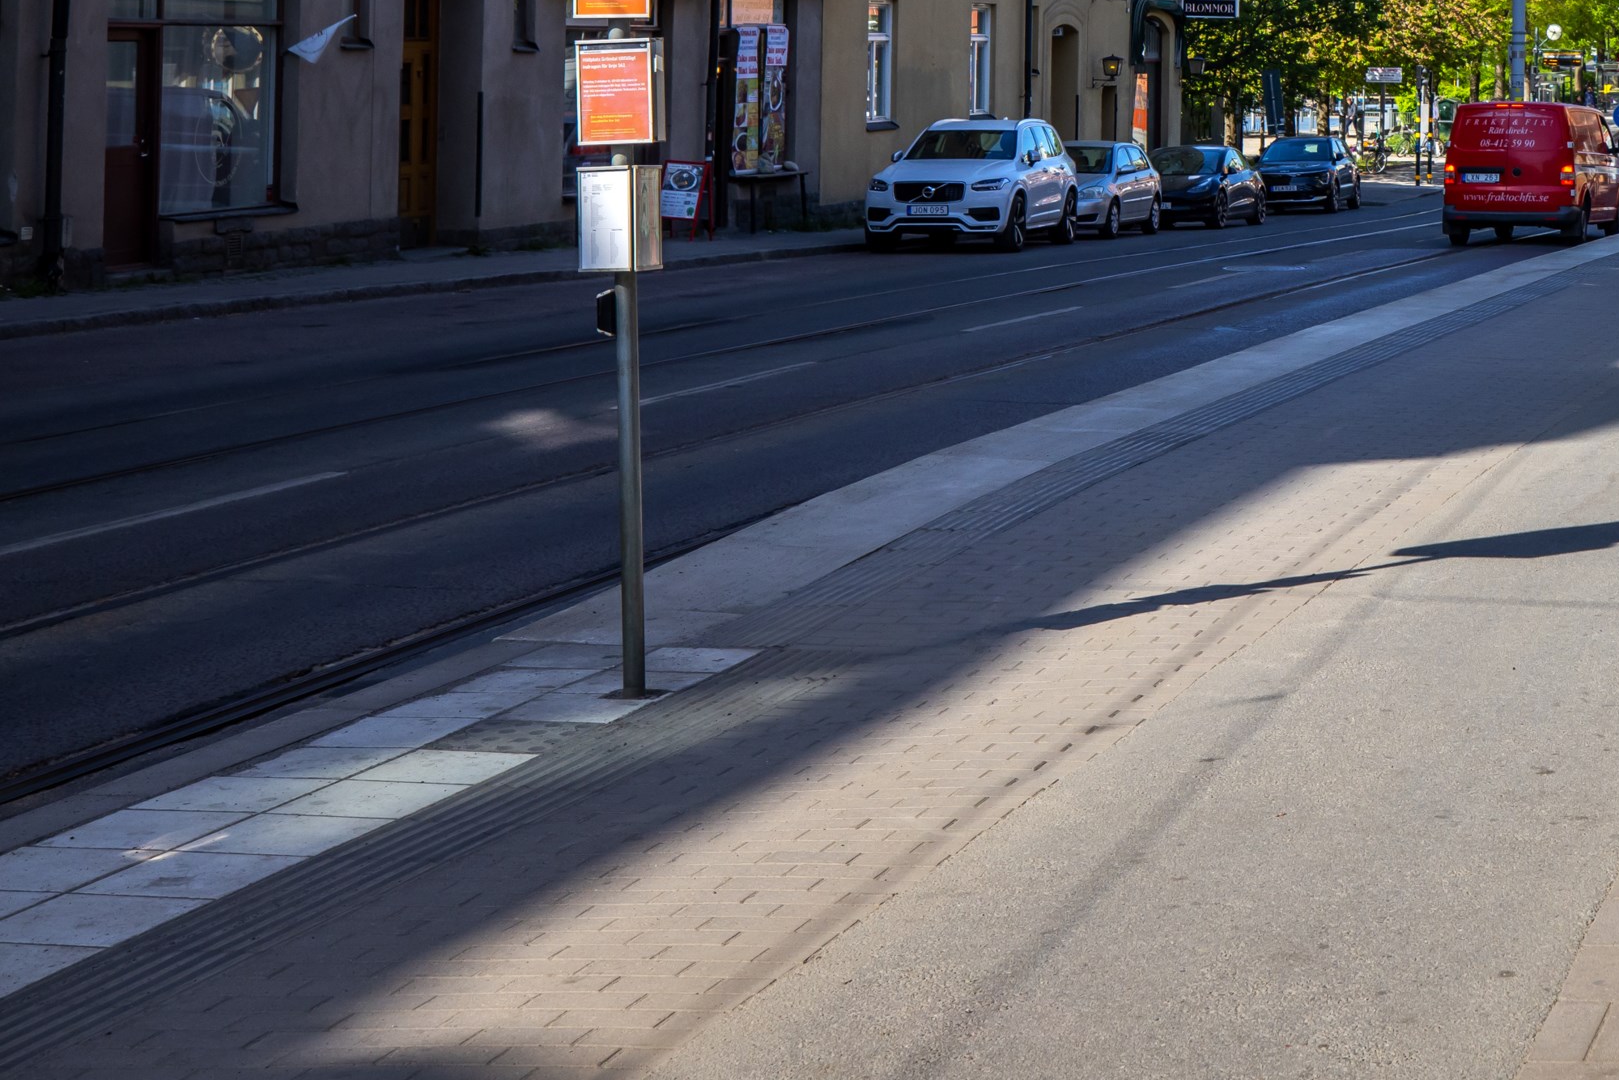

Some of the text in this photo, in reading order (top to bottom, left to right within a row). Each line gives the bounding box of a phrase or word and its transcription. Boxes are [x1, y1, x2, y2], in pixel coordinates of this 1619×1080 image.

[1184, 2, 1235, 14] BLOMMOR
[1465, 118, 1506, 126] FRAKT
[1512, 118, 1519, 126] &
[1488, 126, 1529, 134] Rätt direkt
[1480, 138, 1535, 148] 08-412 59 90
[1466, 173, 1499, 182] LXN 263
[1463, 191, 1550, 203] www.fraktochfix.se
[913, 206, 945, 214] JON 095
